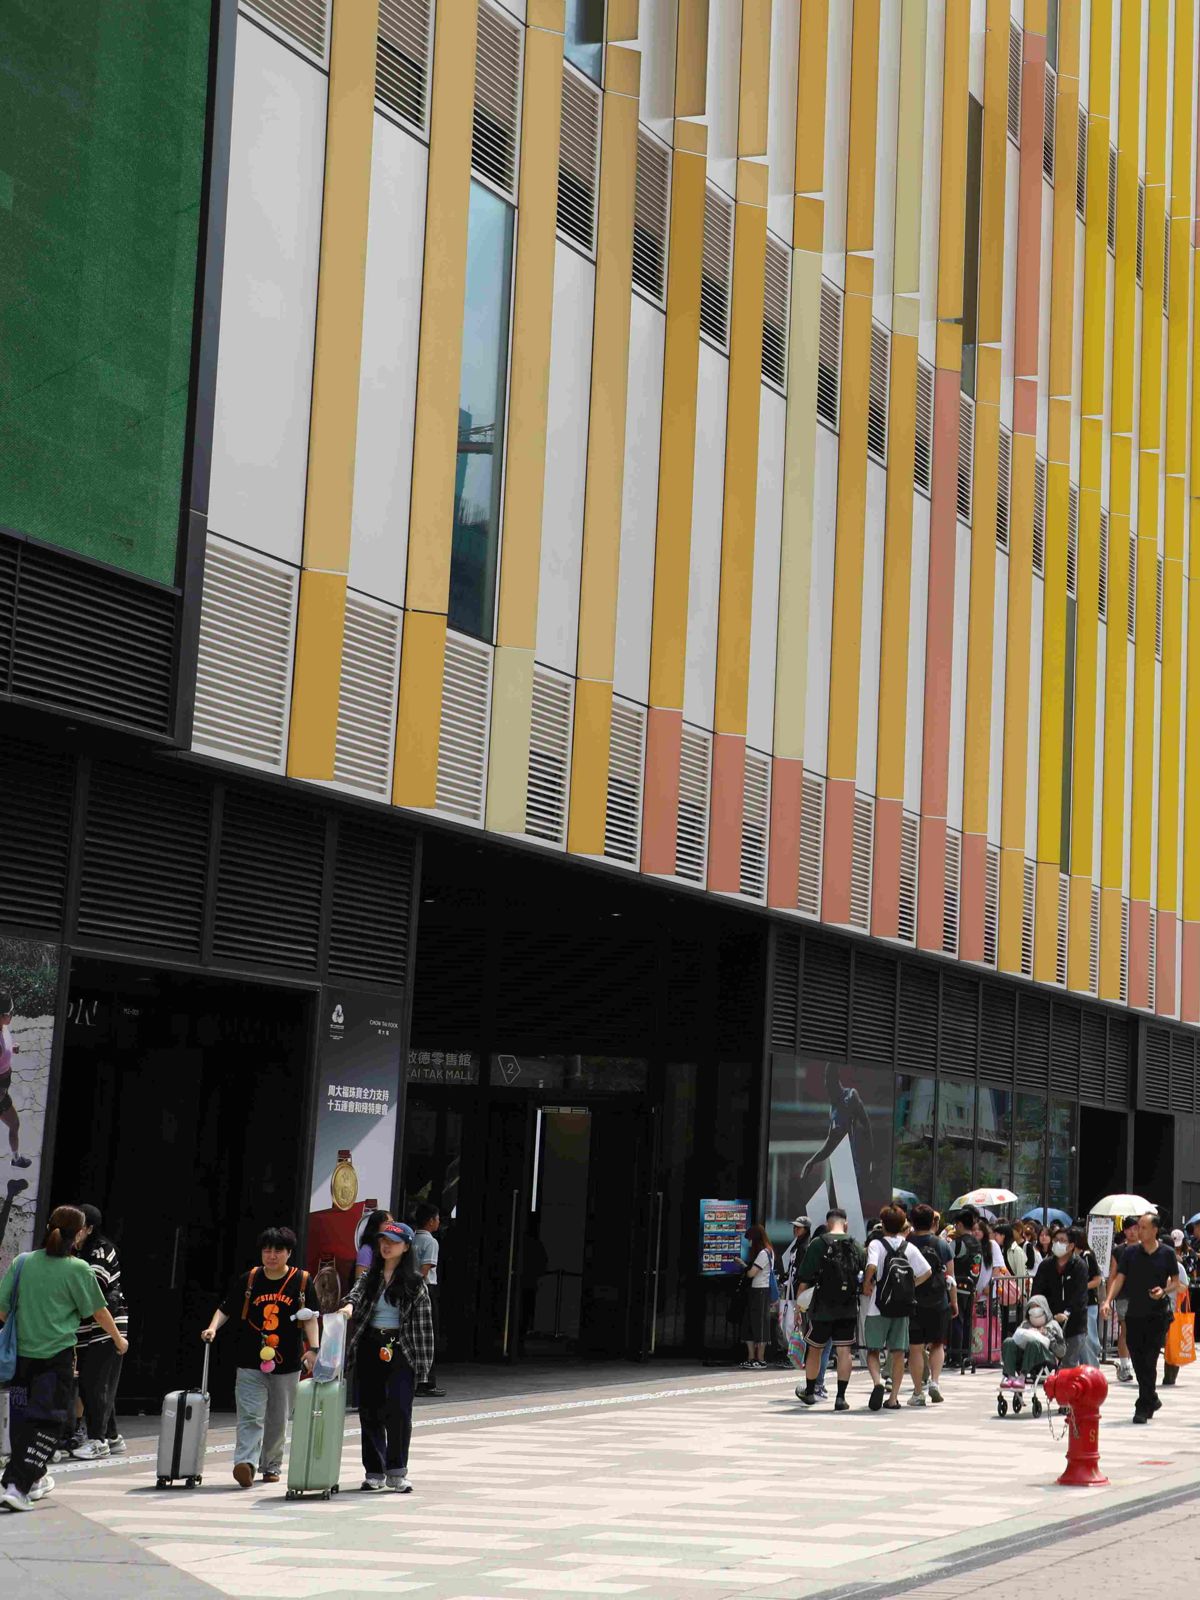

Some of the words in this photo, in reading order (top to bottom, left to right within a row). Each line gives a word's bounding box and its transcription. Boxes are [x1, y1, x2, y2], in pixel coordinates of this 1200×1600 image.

[506, 1063, 515, 1074] 2
[423, 1069, 444, 1080] TAK
[445, 1069, 474, 1081] MALL
[263, 1304, 279, 1331] S
